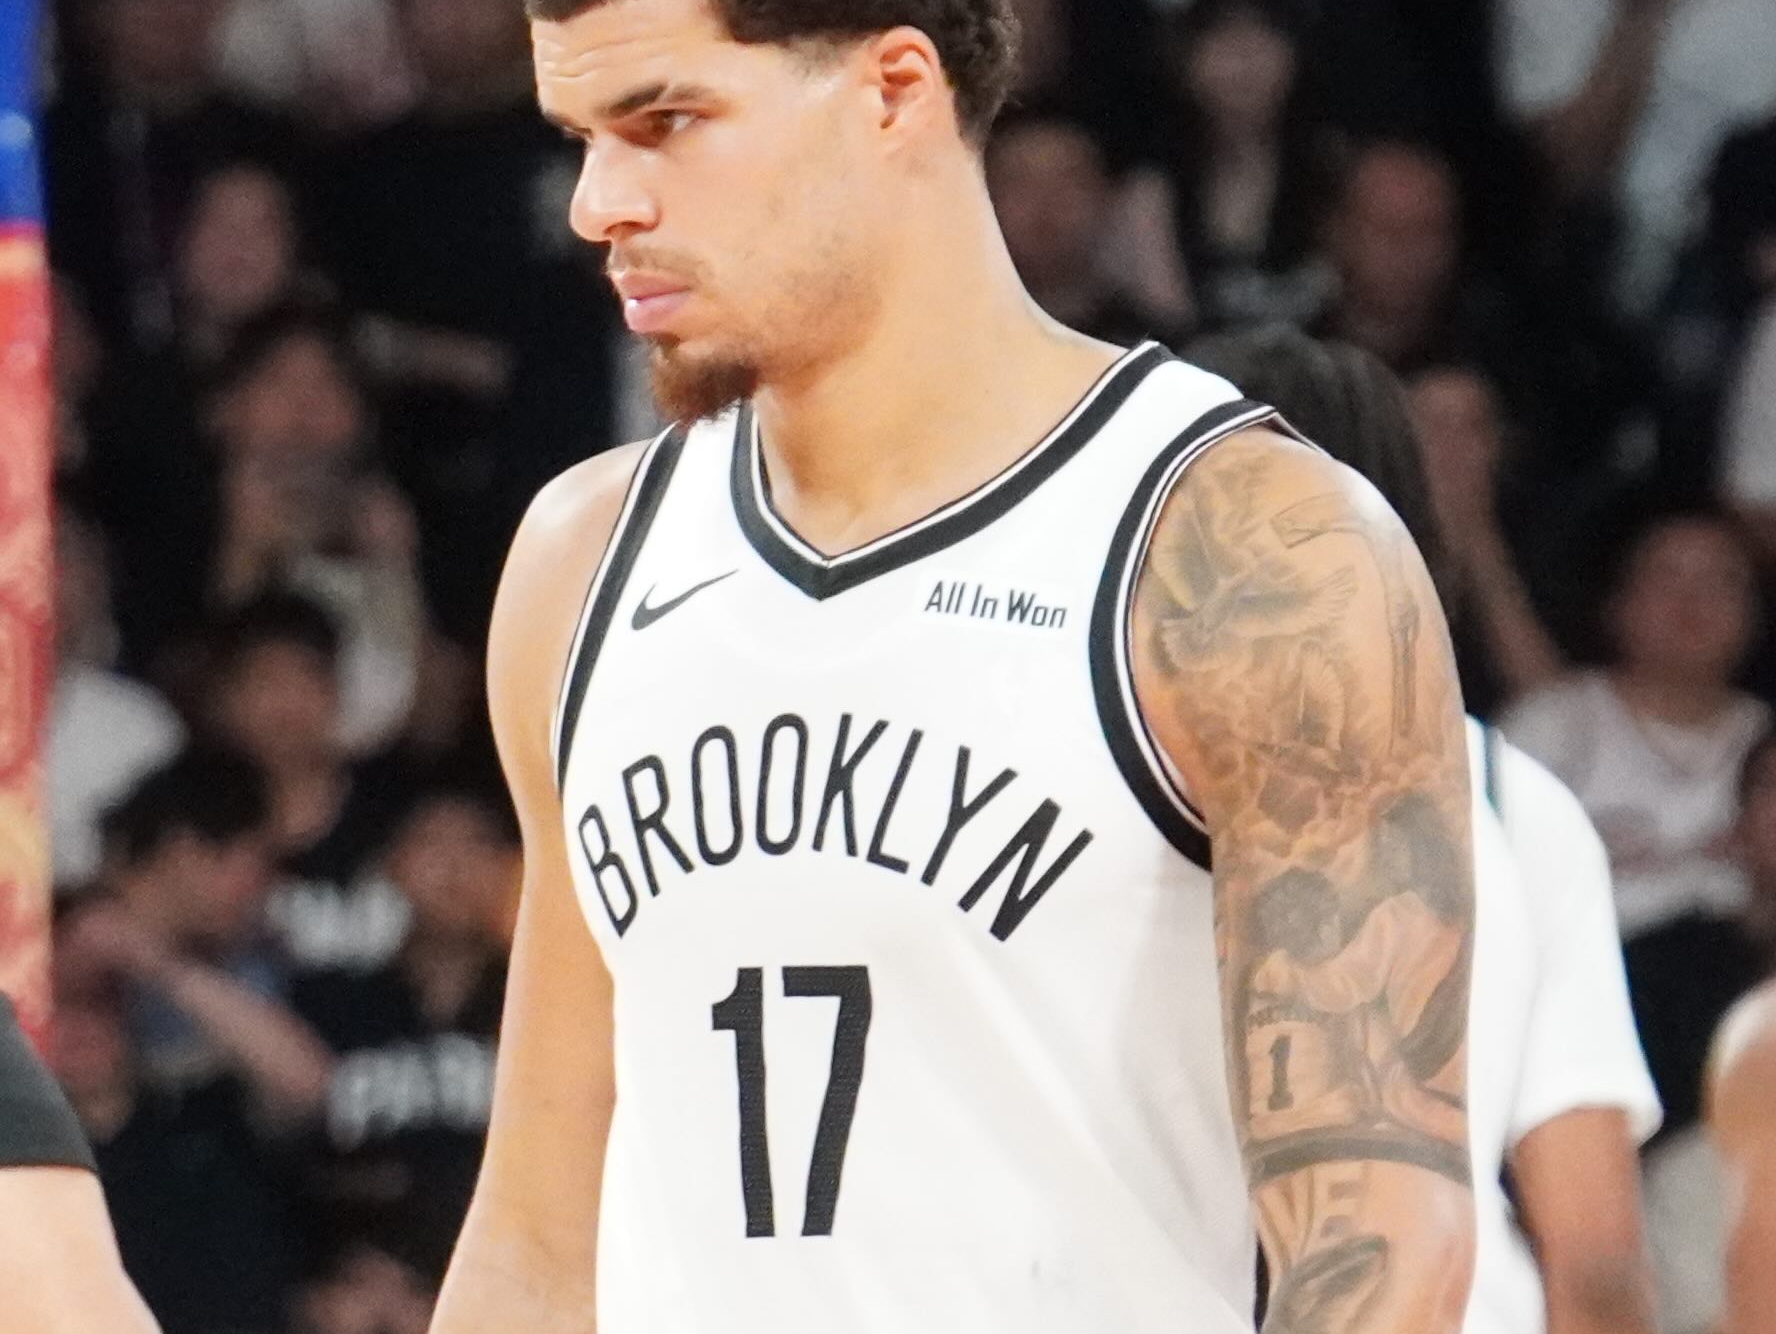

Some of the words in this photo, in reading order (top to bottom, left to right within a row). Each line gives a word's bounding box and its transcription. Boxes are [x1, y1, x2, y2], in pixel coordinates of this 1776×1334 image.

[924, 580, 966, 614] All
[970, 584, 999, 619] In
[1006, 589, 1068, 628] Won
[577, 712, 1094, 943] BROOKLYN
[710, 965, 873, 1238] 17
